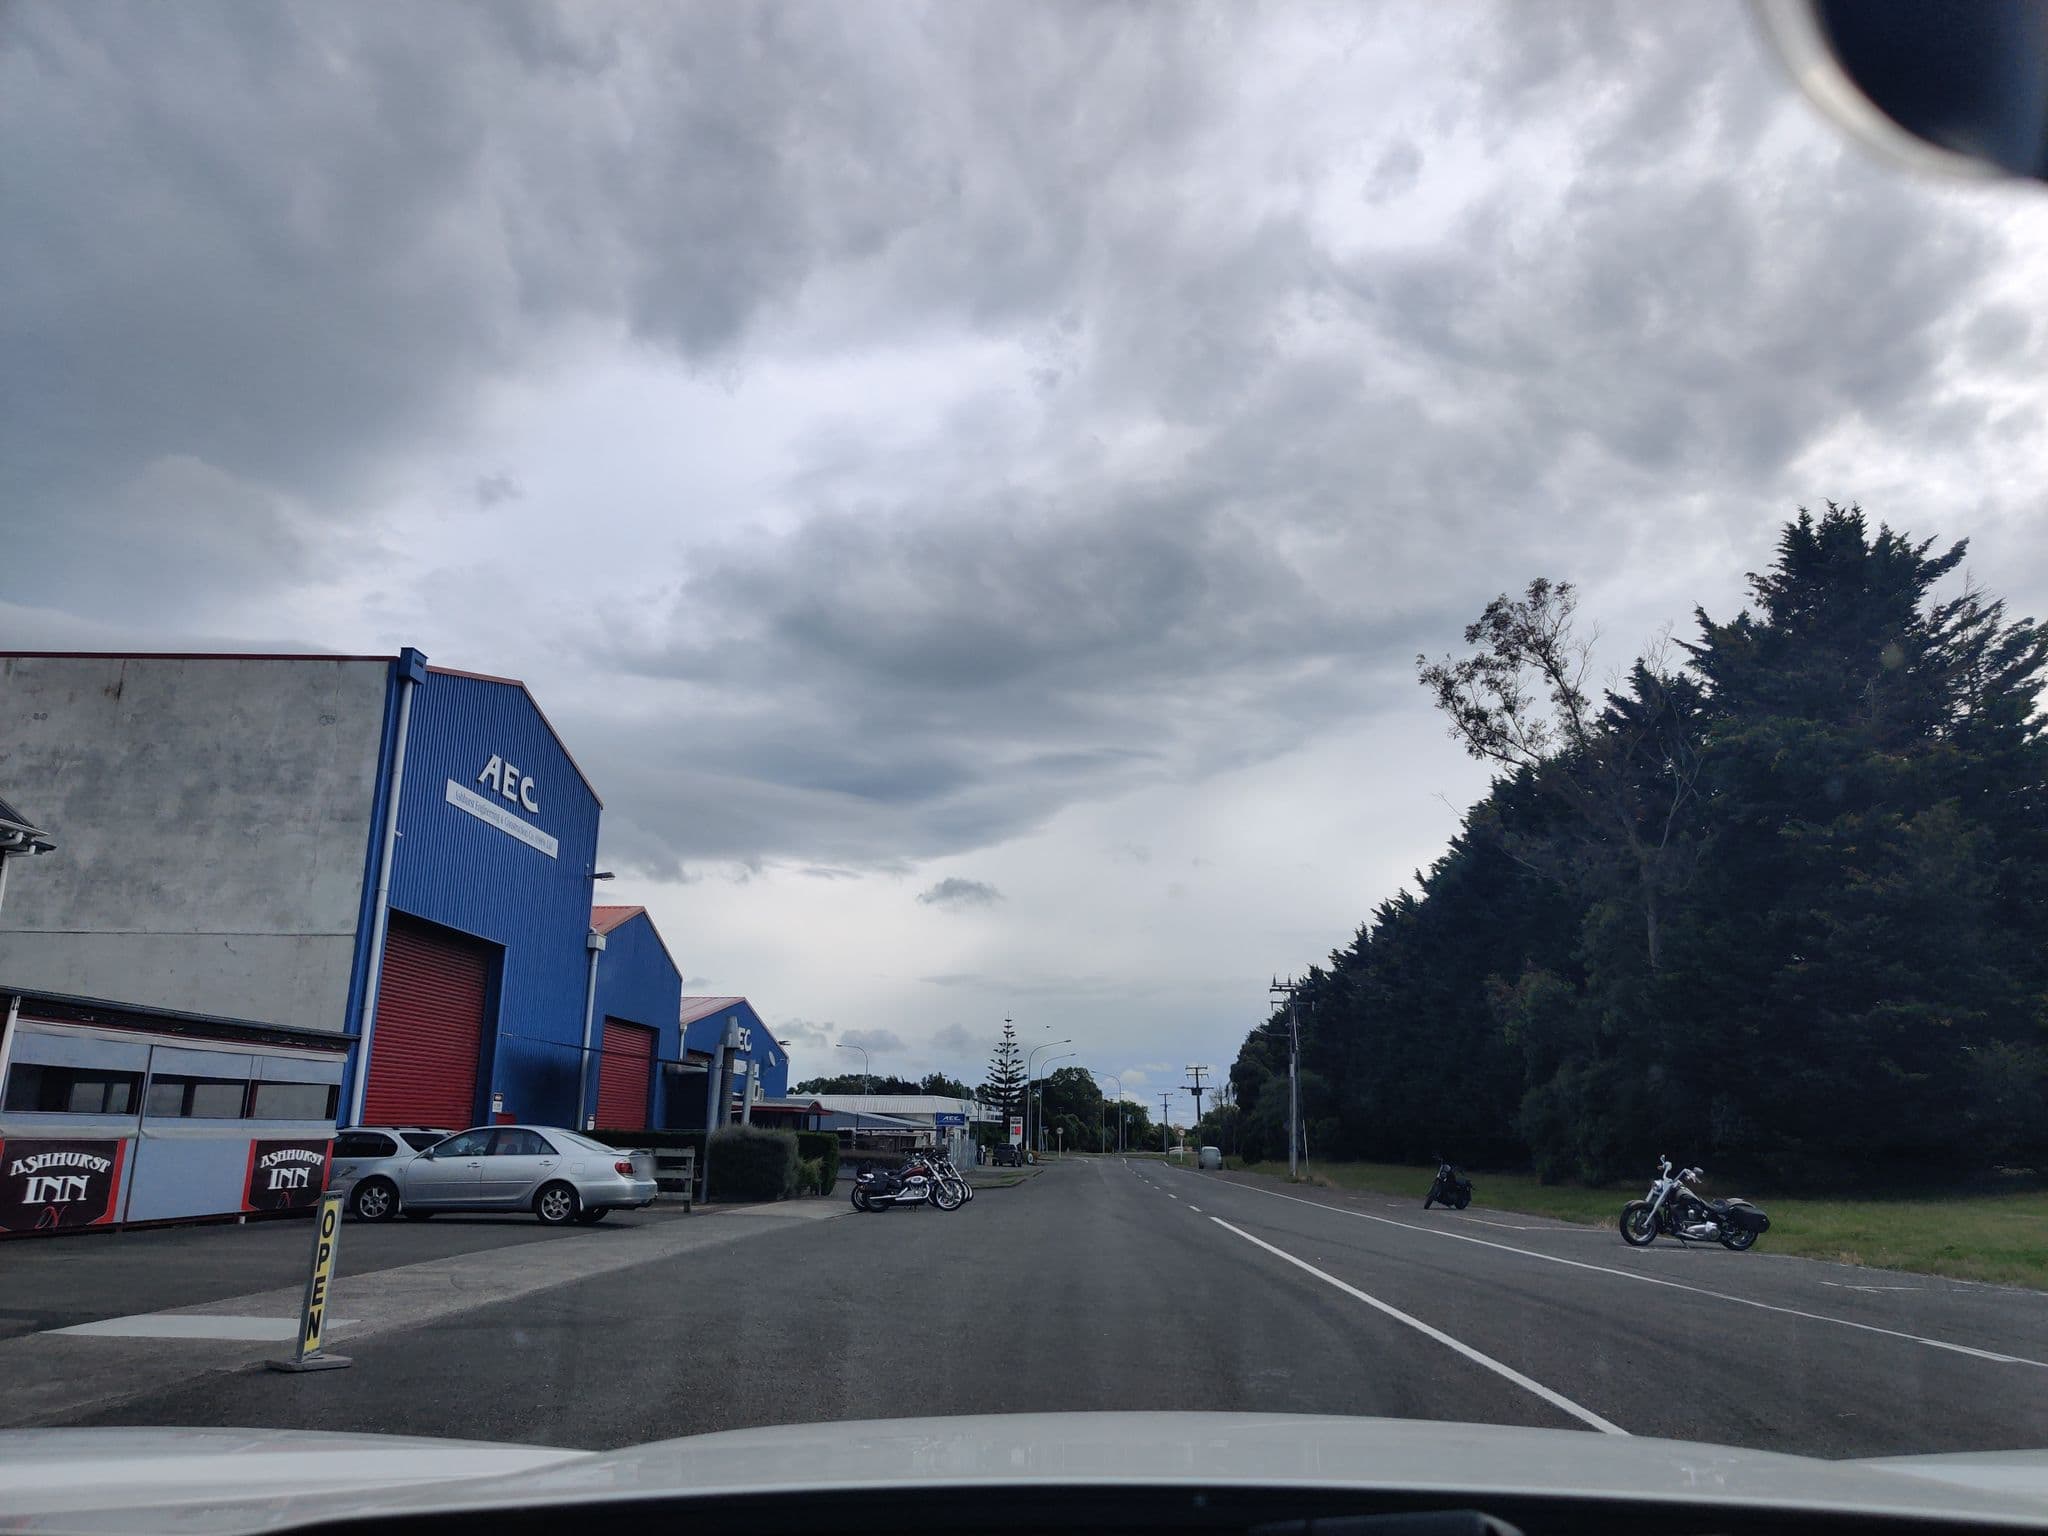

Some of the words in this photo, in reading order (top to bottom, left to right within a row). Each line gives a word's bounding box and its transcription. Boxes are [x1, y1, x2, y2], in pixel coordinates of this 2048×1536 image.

[478, 754, 539, 813] AEC
[738, 1026, 753, 1052] EC
[9, 1152, 111, 1176] ASHHURST
[260, 1149, 324, 1168] ASHHURST
[22, 1175, 90, 1204] INN
[267, 1167, 311, 1190] INN
[306, 1209, 336, 1341] OPEN
